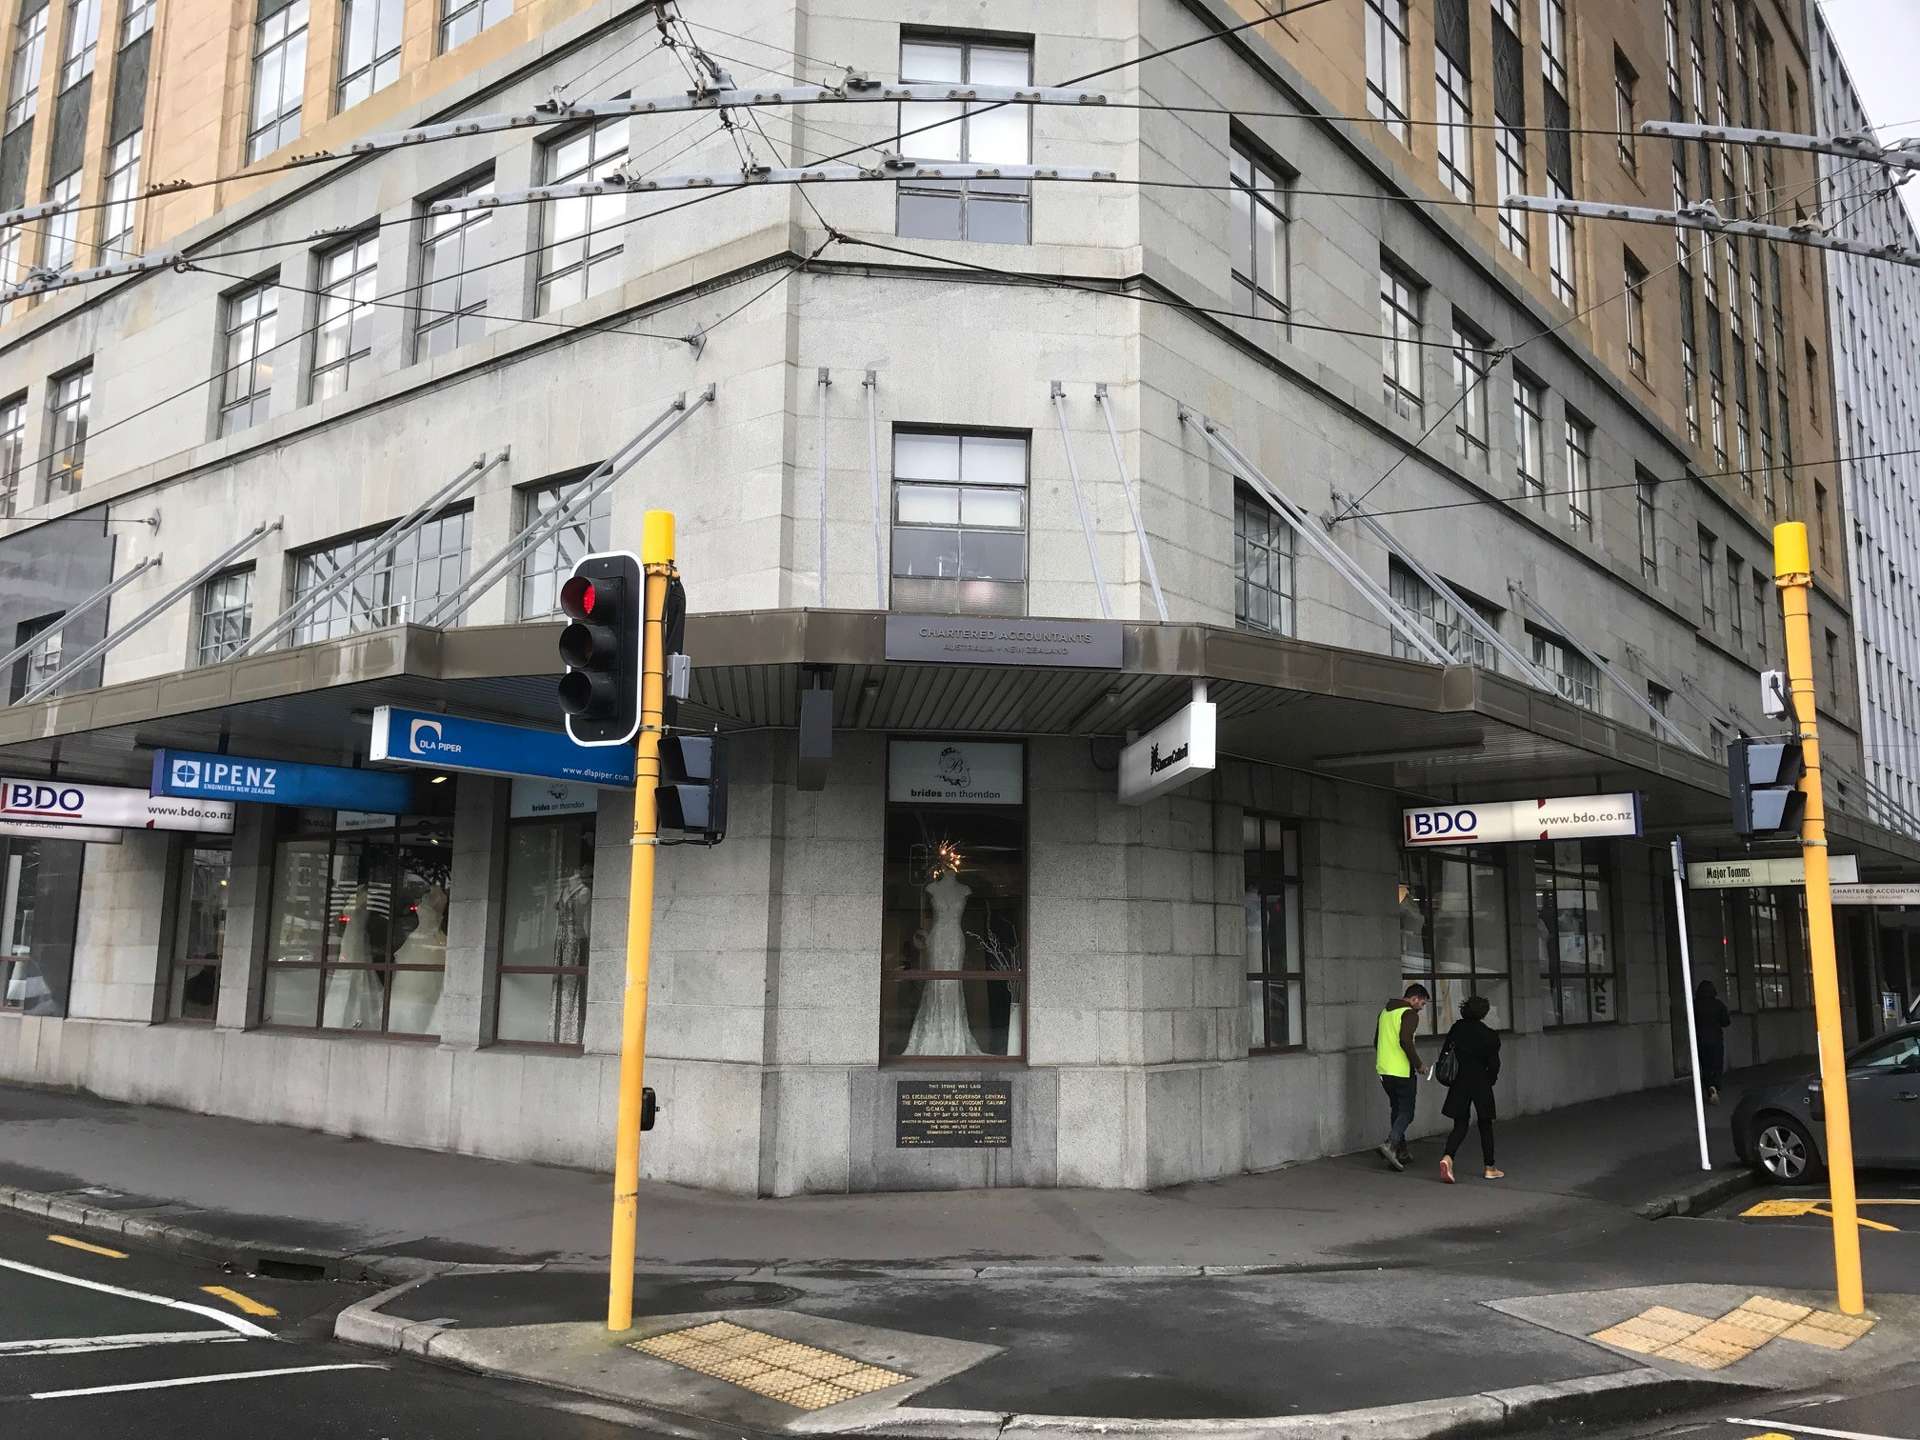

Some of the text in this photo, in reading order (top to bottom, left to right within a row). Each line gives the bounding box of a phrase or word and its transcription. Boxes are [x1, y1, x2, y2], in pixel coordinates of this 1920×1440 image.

[919, 628, 1092, 644] CHARTERED ACCOUNTANTS
[420, 740, 462, 752] DLA PIPER
[204, 762, 276, 788] IPENZ
[562, 767, 630, 781] www.dlapiper.com
[204, 783, 235, 792] ENGINEERS
[250, 787, 276, 795] ZEALAND
[911, 788, 1000, 799] brides on thorndon
[12, 784, 84, 811] BDO
[147, 805, 233, 820] www.bdo.co.nz
[1538, 812, 1632, 826] www.bdo.co.nz
[1414, 810, 1477, 835] BDO
[1706, 867, 1726, 880] Major
